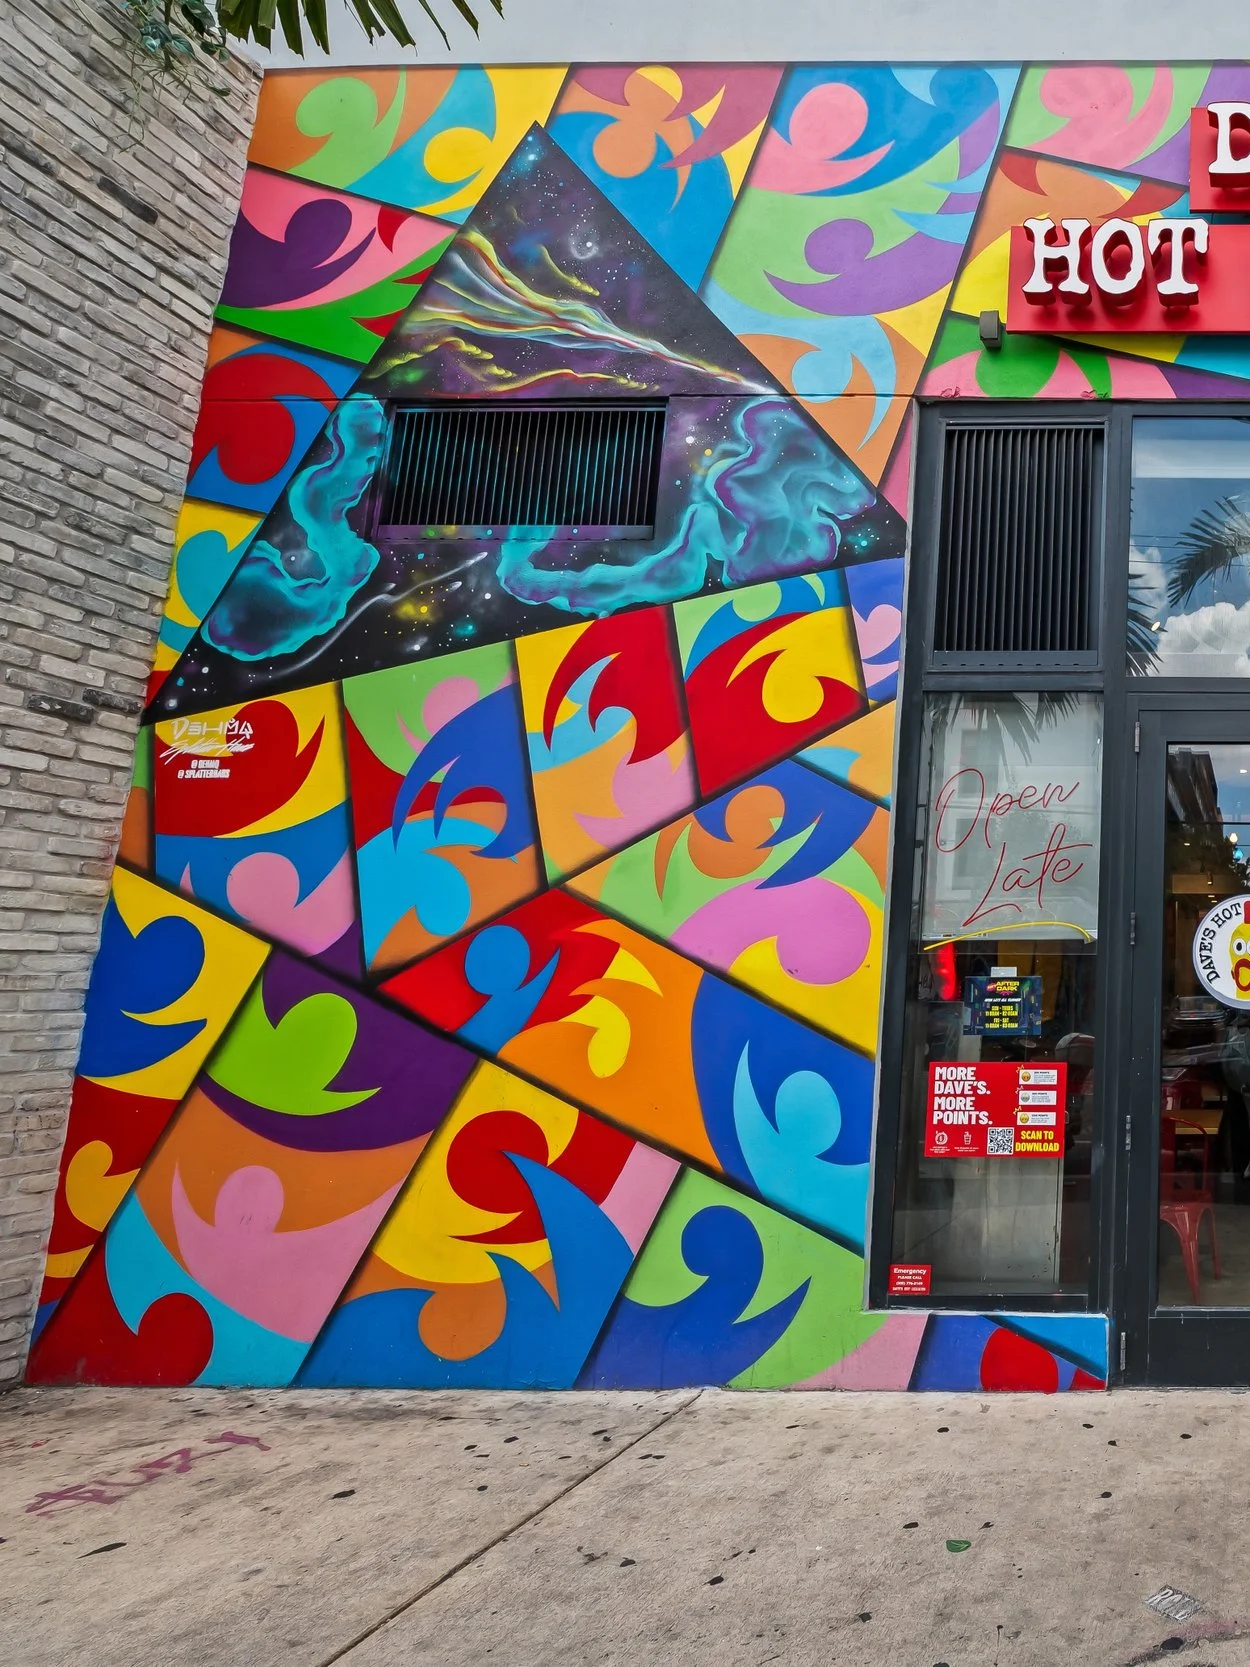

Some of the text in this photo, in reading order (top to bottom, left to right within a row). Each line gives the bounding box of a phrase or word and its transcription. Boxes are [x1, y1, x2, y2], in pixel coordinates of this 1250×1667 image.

[1022, 217, 1209, 302] HOT
[935, 768, 1080, 853] Open
[962, 823, 1093, 926] Late
[1199, 927, 1220, 984] DAVE'S
[1211, 902, 1242, 928] HOT
[935, 1066, 976, 1080] MORE
[934, 1081, 991, 1095] DAVE'S.
[934, 1096, 976, 1110] MORE
[932, 1111, 993, 1125] POINTS.
[1021, 1130, 1054, 1140] SCAN TO
[1015, 1142, 1059, 1151] DOWNLOAD
